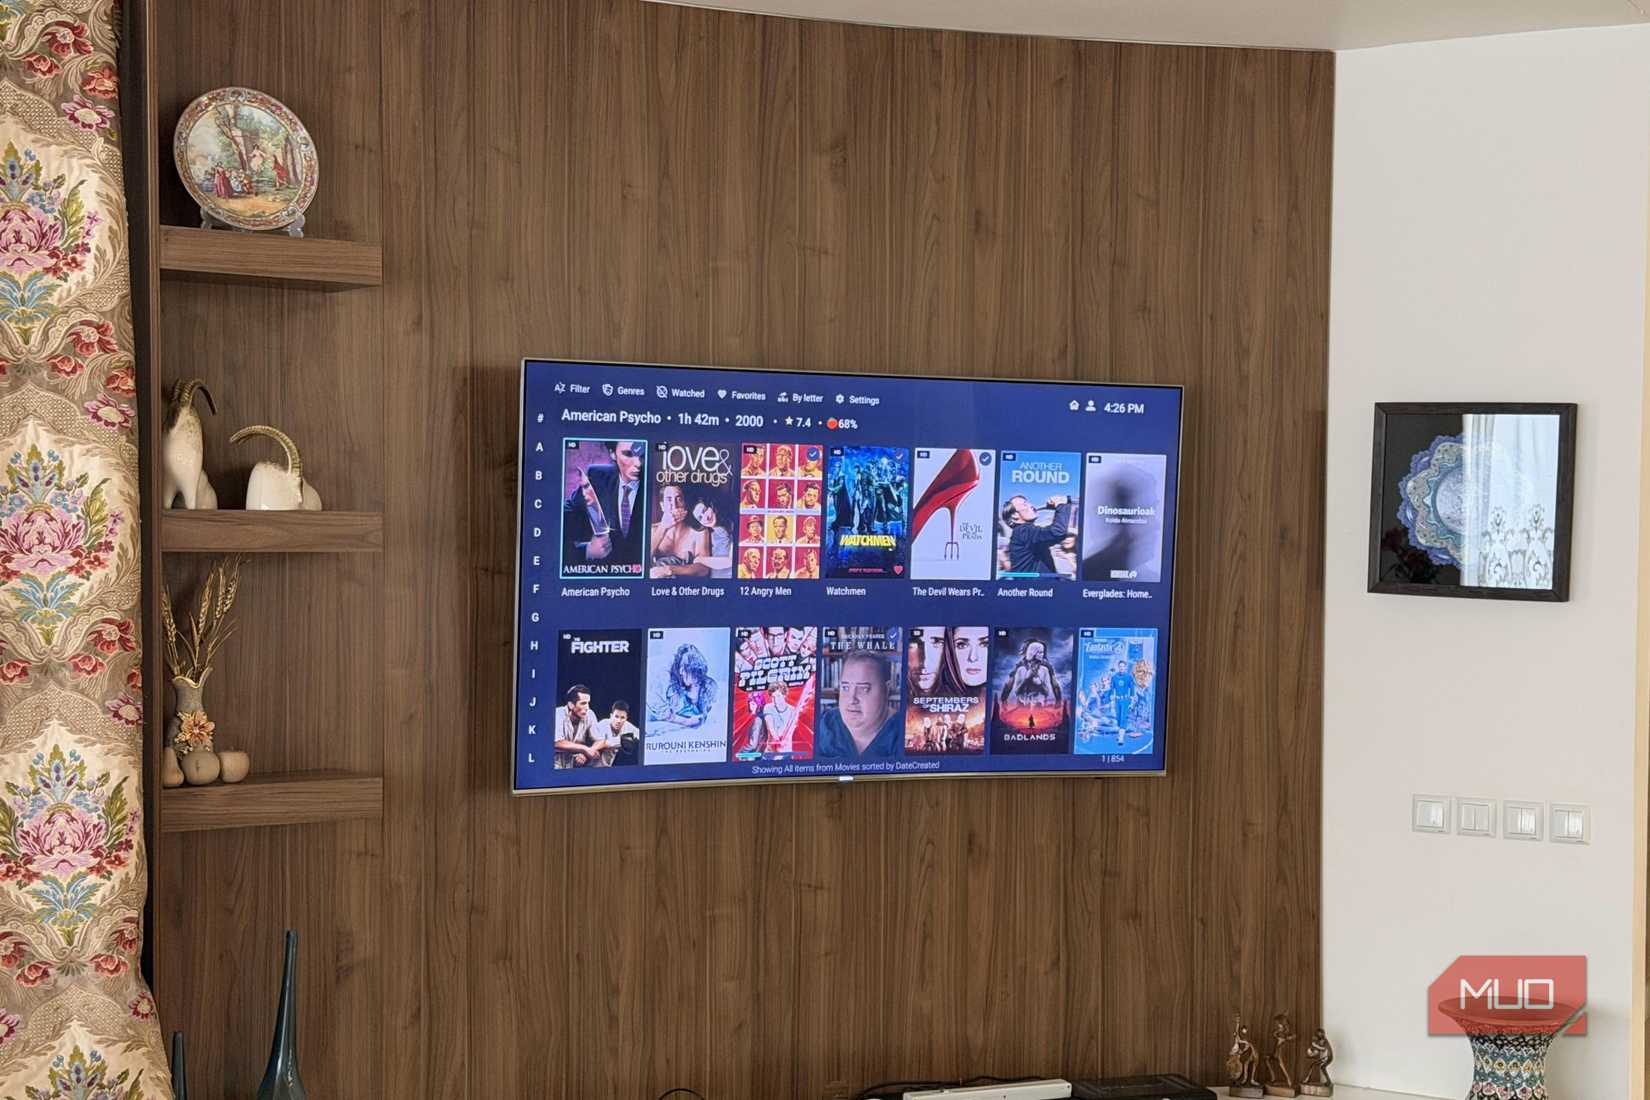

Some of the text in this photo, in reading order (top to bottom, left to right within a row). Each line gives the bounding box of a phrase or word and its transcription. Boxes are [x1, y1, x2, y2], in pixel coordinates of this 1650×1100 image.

[570, 384, 590, 394] Filter
[618, 386, 644, 396] Genres
[672, 387, 705, 398] Watched
[732, 390, 766, 400] Favorites
[792, 394, 824, 403] By letter
[850, 395, 880, 406] Settings
[1104, 402, 1144, 414] 4:26 PM
[561, 409, 858, 429] American Psycho 1h 42m 2000 7.4 68%
[536, 442, 544, 451] A
[536, 470, 542, 480] B
[656, 469, 728, 487] other drugs
[1012, 470, 1070, 484] ROUND
[534, 499, 542, 508] C
[534, 528, 541, 537] D
[840, 534, 896, 548] WATCHMEN
[533, 556, 540, 566] E
[563, 564, 608, 574] AMERICAN
[532, 584, 540, 594] F
[560, 586, 630, 598] American Psycho
[652, 586, 724, 598] Love & Other Drugs
[740, 586, 792, 598] 12 Angry Men
[826, 586, 866, 596] Watchmen
[912, 587, 926, 596] The
[928, 587, 946, 596] Devil
[948, 588, 970, 596] Wears
[997, 588, 1054, 598] Another Round
[1082, 588, 1125, 600] Everglades:
[532, 612, 540, 622] G
[530, 640, 538, 650] H
[571, 640, 630, 654] FIGHTER
[857, 641, 895, 650] WHALE
[754, 655, 796, 670] SCOTT
[528, 697, 536, 706] J
[913, 696, 979, 704] SEPTEMBERS
[930, 704, 970, 712] SHIRAZ
[528, 725, 536, 734] K
[646, 740, 726, 750] RUROUNI KENSHIN
[528, 754, 535, 763] L
[752, 765, 783, 774] Showing
[784, 764, 793, 772] All
[816, 764, 834, 772] from
[834, 763, 860, 772] Movies
[862, 762, 884, 771] sorted
[886, 762, 894, 772] by
[896, 761, 940, 770] DateCreated
